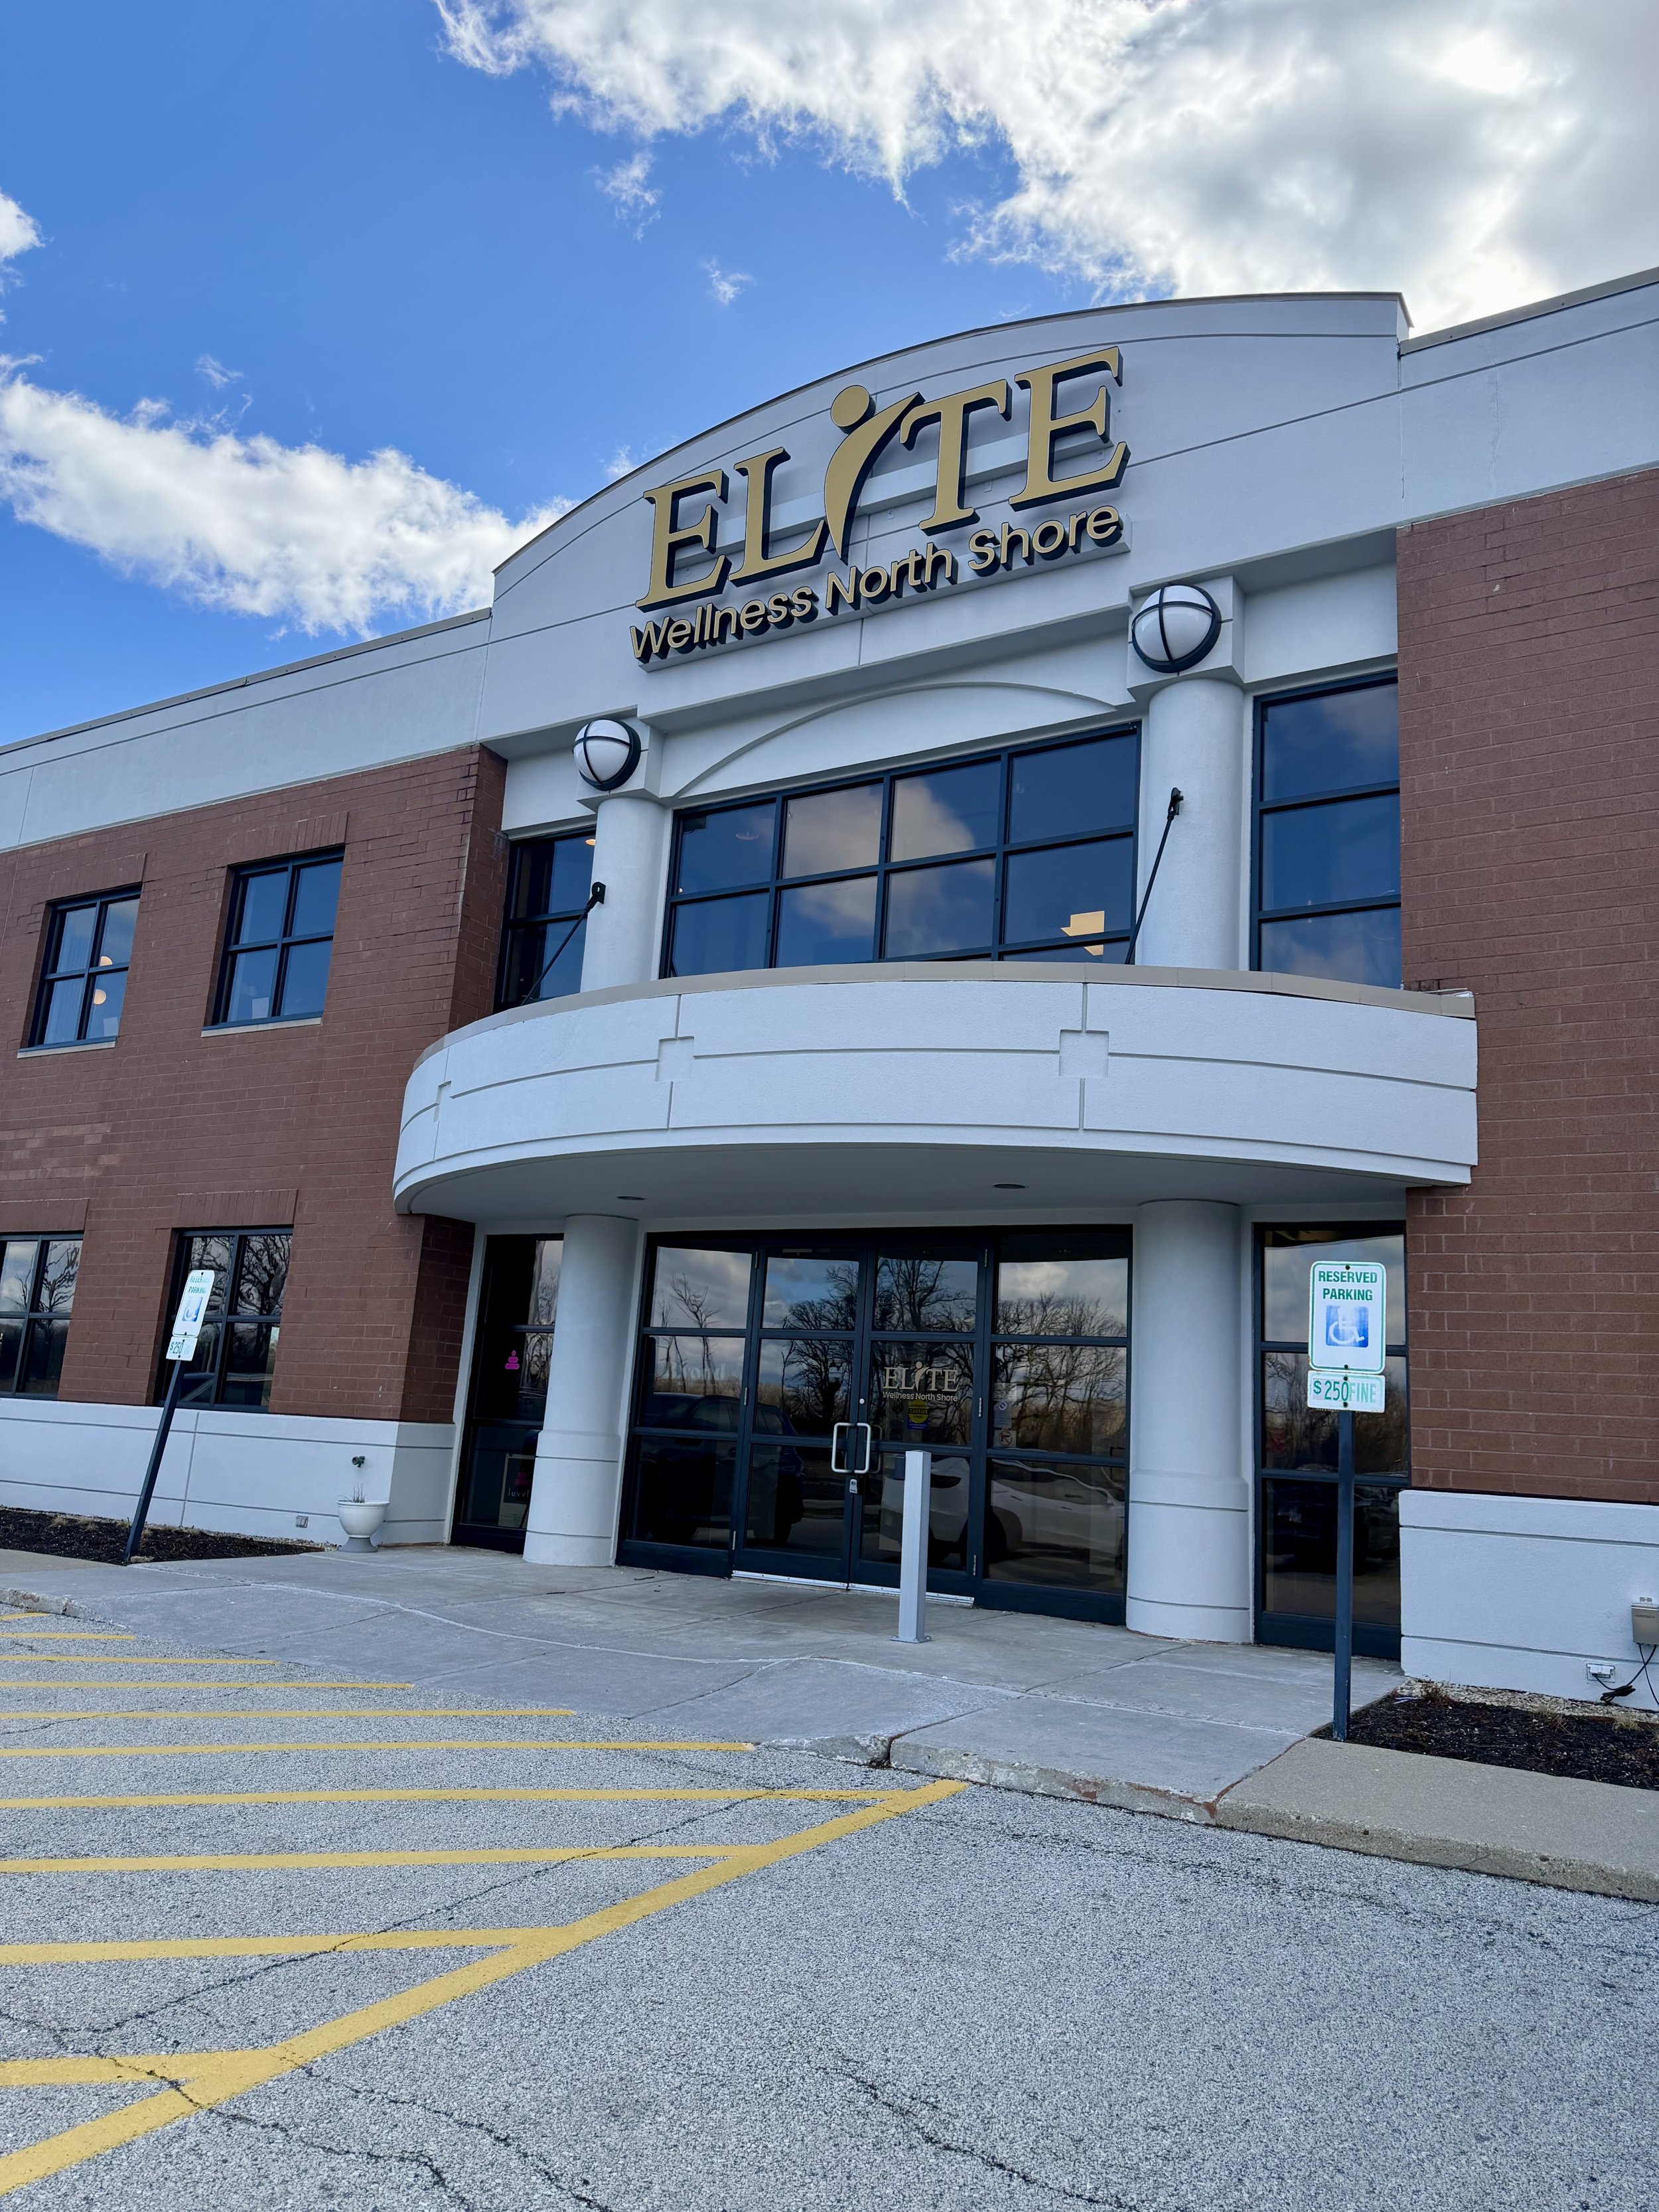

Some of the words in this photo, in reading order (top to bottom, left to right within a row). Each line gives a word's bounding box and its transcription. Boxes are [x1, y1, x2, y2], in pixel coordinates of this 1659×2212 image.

[629, 585, 819, 664] Wellness
[826, 541, 958, 615] North
[967, 505, 1125, 577] Shore
[1318, 1270, 1378, 1284] RESERVED
[188, 1286, 206, 1294] PARKING
[1323, 1288, 1373, 1301] PARKING
[883, 1391, 914, 1400] Wellness
[915, 1392, 935, 1401] North
